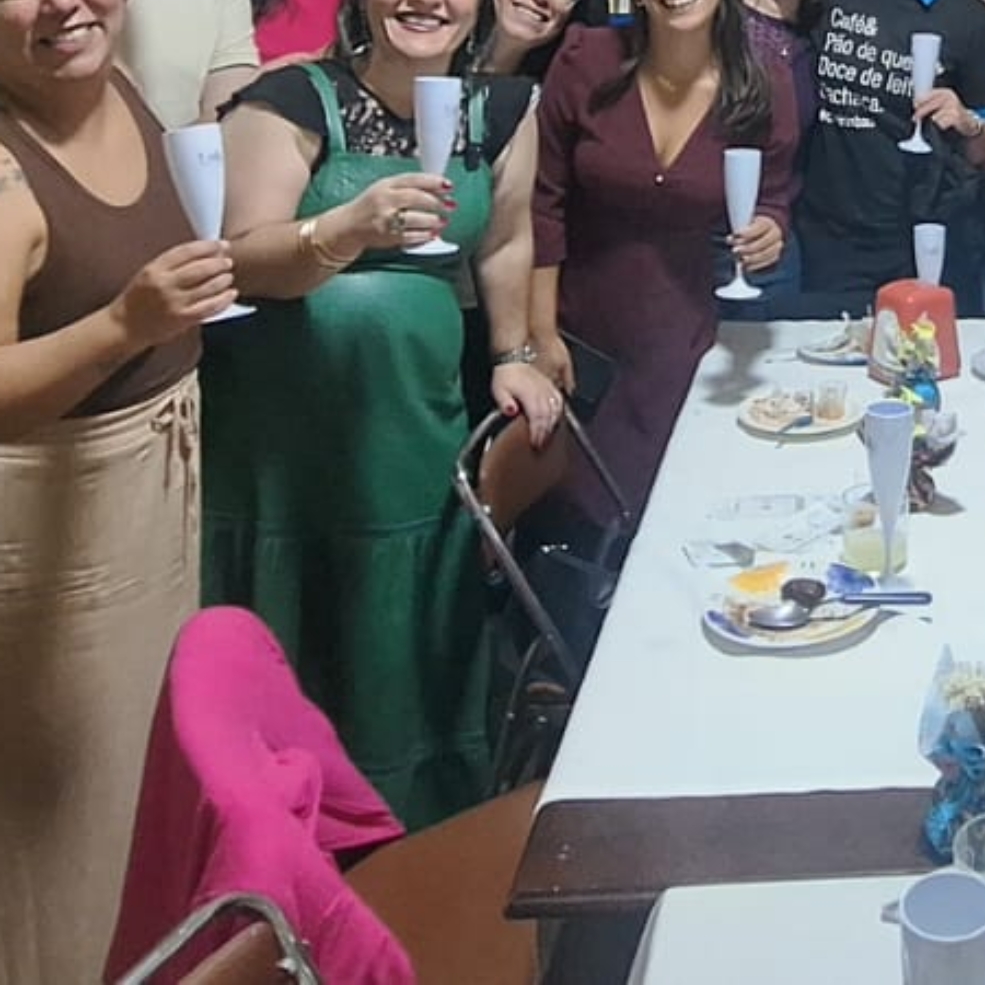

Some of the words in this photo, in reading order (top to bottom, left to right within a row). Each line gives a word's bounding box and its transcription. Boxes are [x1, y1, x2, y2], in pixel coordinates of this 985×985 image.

[824, 32, 854, 55] Pão
[857, 41, 877, 62] de
[818, 55, 857, 82] Doce
[860, 66, 883, 89] de
